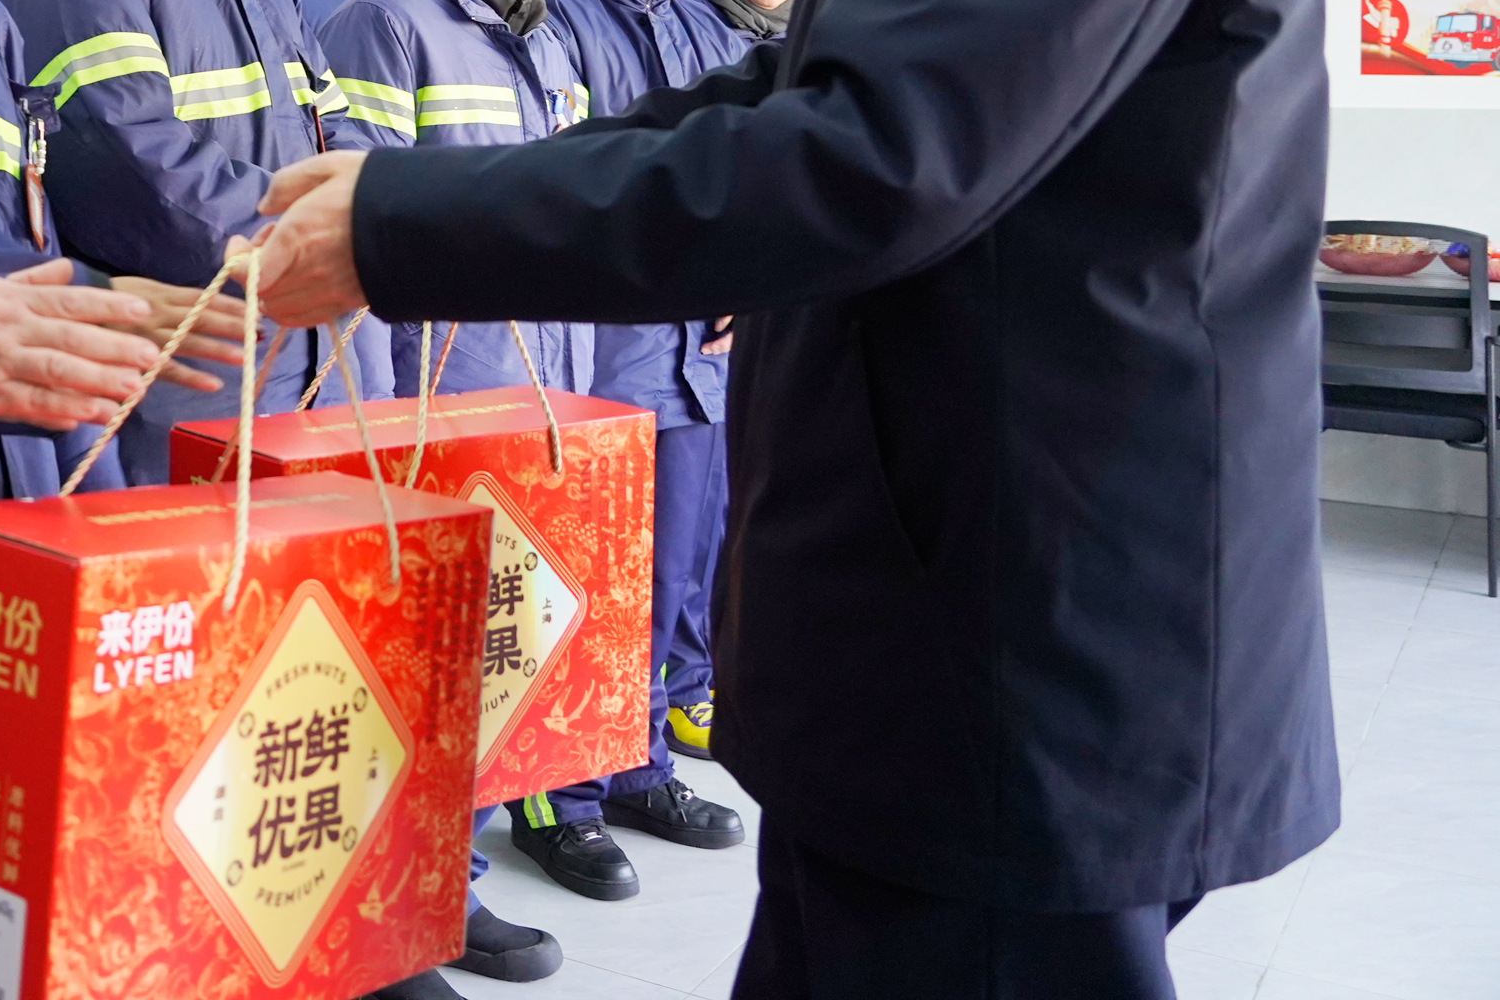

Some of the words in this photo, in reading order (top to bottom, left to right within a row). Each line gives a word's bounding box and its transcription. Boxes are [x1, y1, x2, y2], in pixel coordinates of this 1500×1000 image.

[514, 432, 546, 445] LYFEN
[495, 533, 517, 550] UTS
[488, 563, 524, 620] 鲜
[96, 600, 195, 658] 来伊份
[484, 623, 523, 677] 果
[93, 649, 195, 694] LYFEN
[266, 662, 310, 698] FRESH
[313, 661, 347, 685] NUTS
[480, 689, 510, 715] IUM
[253, 702, 350, 788] 新鲜
[248, 783, 343, 869] 优果
[255, 868, 326, 907] PREMIUM
